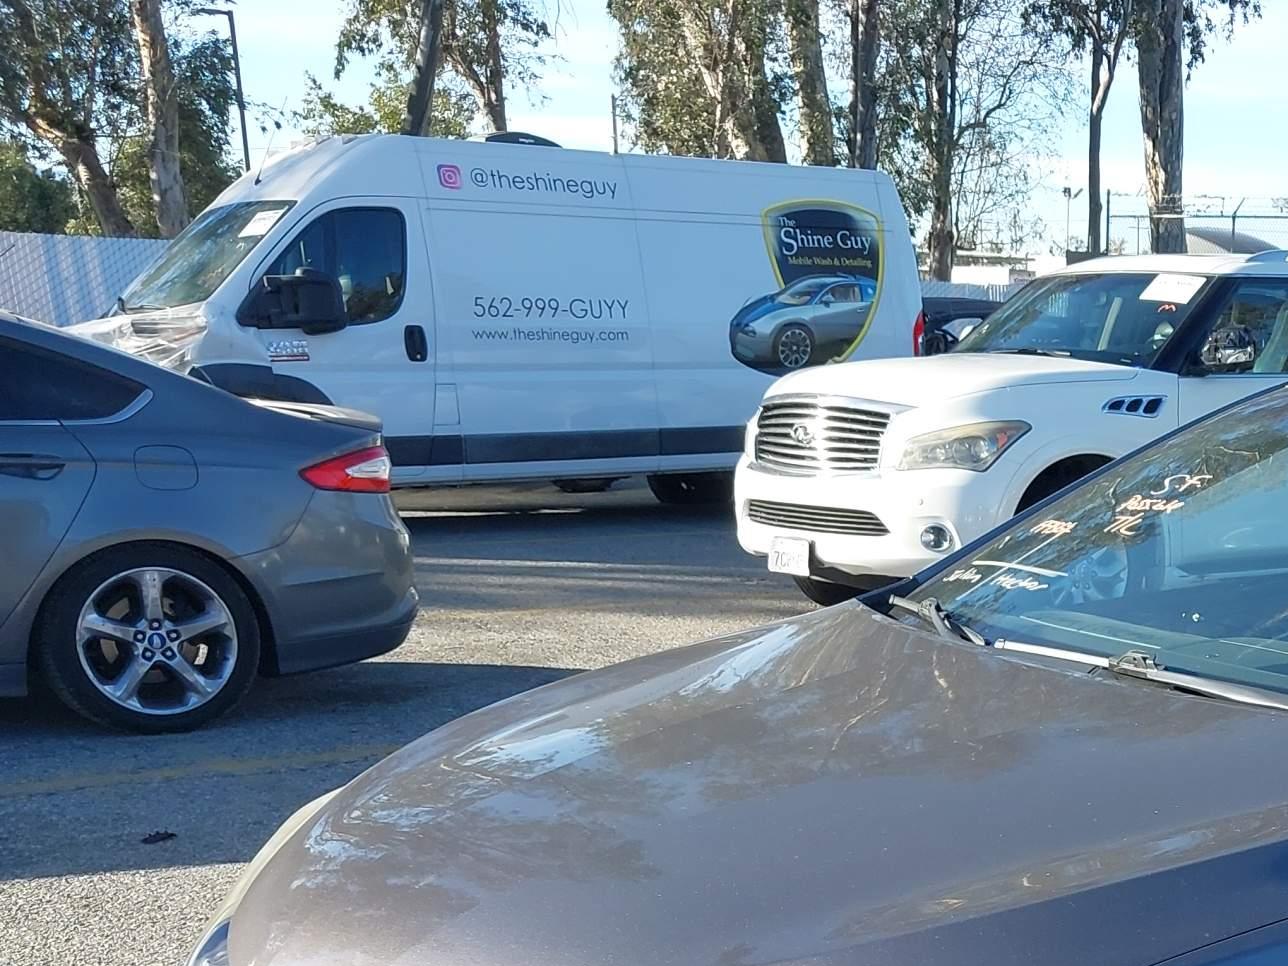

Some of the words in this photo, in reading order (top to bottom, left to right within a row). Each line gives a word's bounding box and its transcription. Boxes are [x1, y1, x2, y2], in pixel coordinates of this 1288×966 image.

[470, 167, 617, 199] @theshineguy
[779, 216, 796, 226] The
[781, 227, 834, 256] Shine
[837, 230, 871, 255] Guy
[788, 256, 812, 265] Mobile
[813, 257, 833, 266] Wash
[841, 257, 872, 268] Detailing
[473, 296, 629, 319] 562-999-GUYY
[472, 328, 629, 343] www.theshineguy.com
